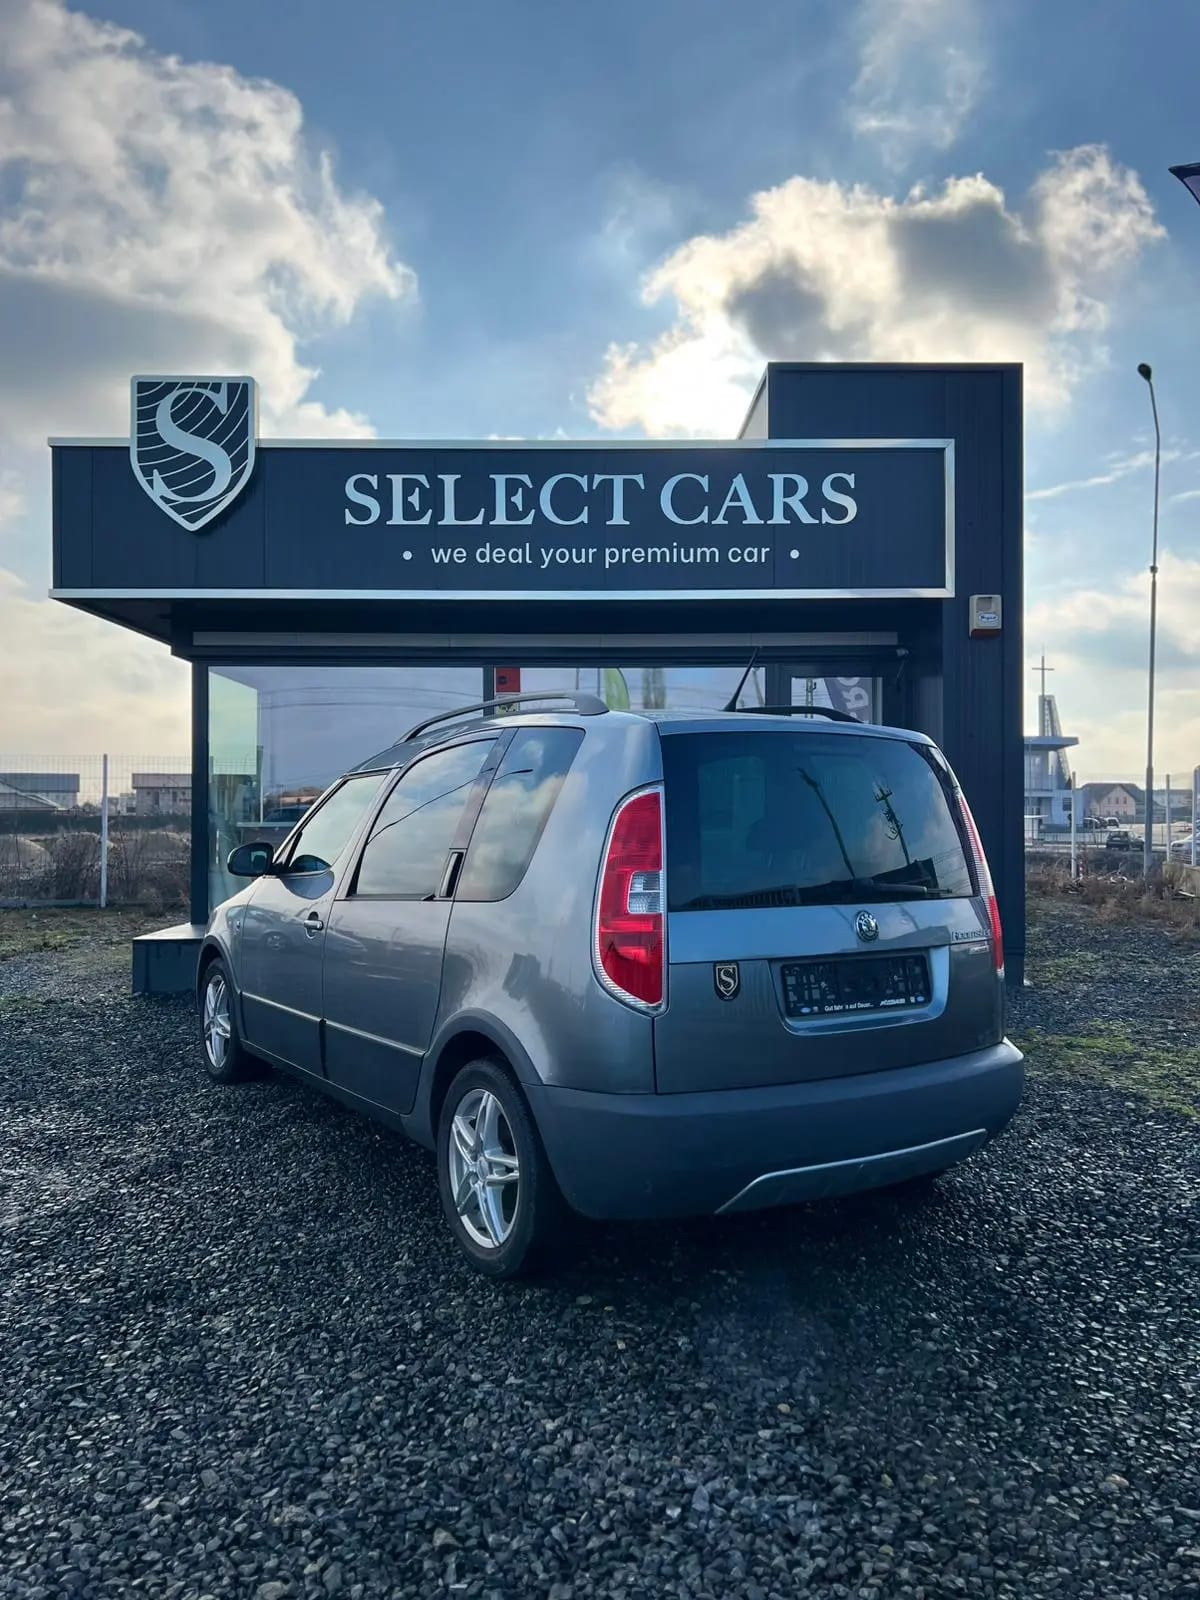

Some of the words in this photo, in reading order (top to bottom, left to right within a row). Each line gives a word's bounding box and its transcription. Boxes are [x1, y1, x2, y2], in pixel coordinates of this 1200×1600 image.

[344, 473, 645, 526] SELECT
[660, 472, 858, 526] CARS
[431, 547, 467, 564] we
[475, 542, 533, 564] deal
[540, 547, 598, 569] your
[605, 541, 720, 569] premium
[727, 547, 771, 564] car
